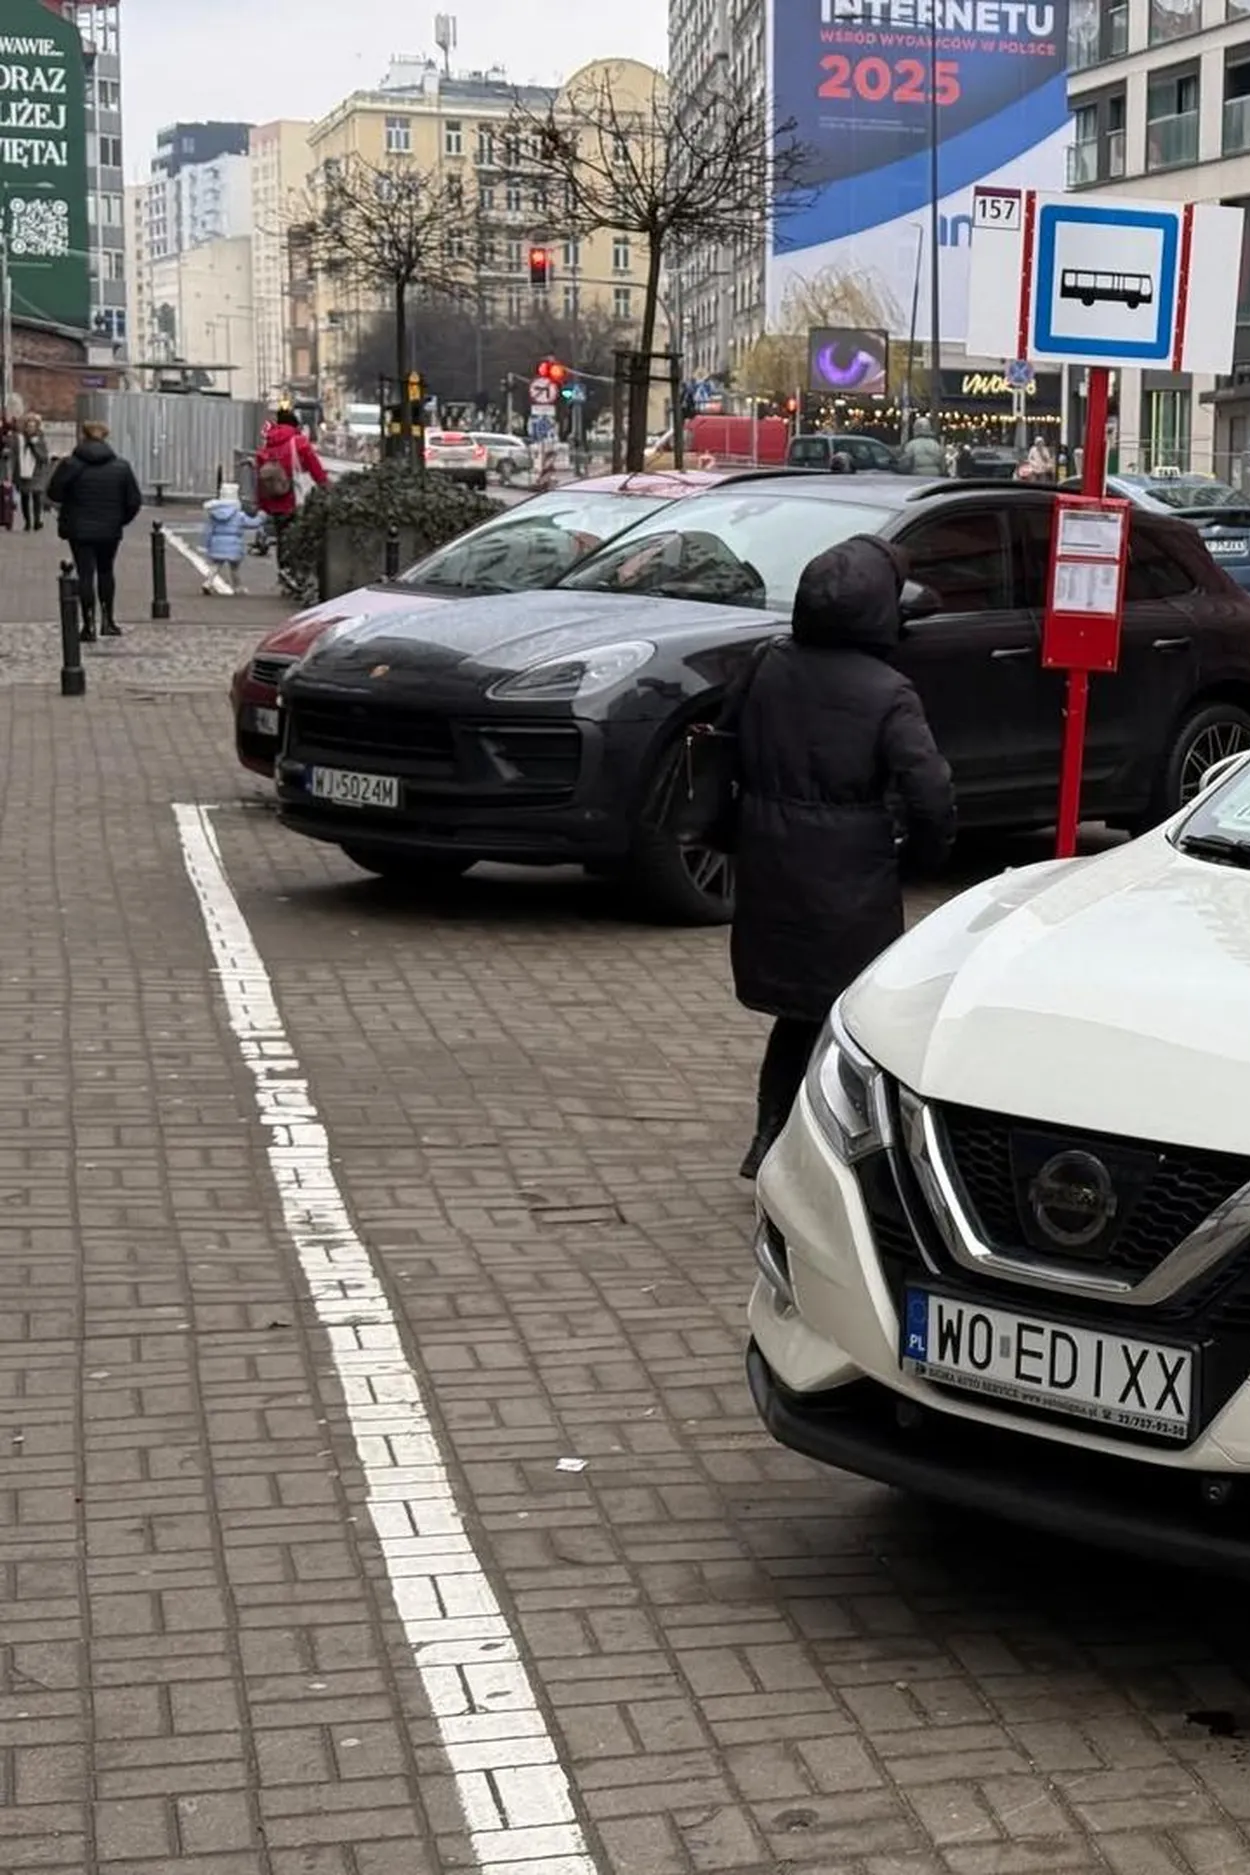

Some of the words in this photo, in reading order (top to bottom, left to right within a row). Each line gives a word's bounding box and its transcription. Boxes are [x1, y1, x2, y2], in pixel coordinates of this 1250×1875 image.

[820, 0, 1054, 36] INTERNETU
[999, 42, 1056, 57] POLSCE
[818, 54, 961, 106] 2025
[979, 199, 1015, 220] 157
[909, 1334, 925, 1352] PL
